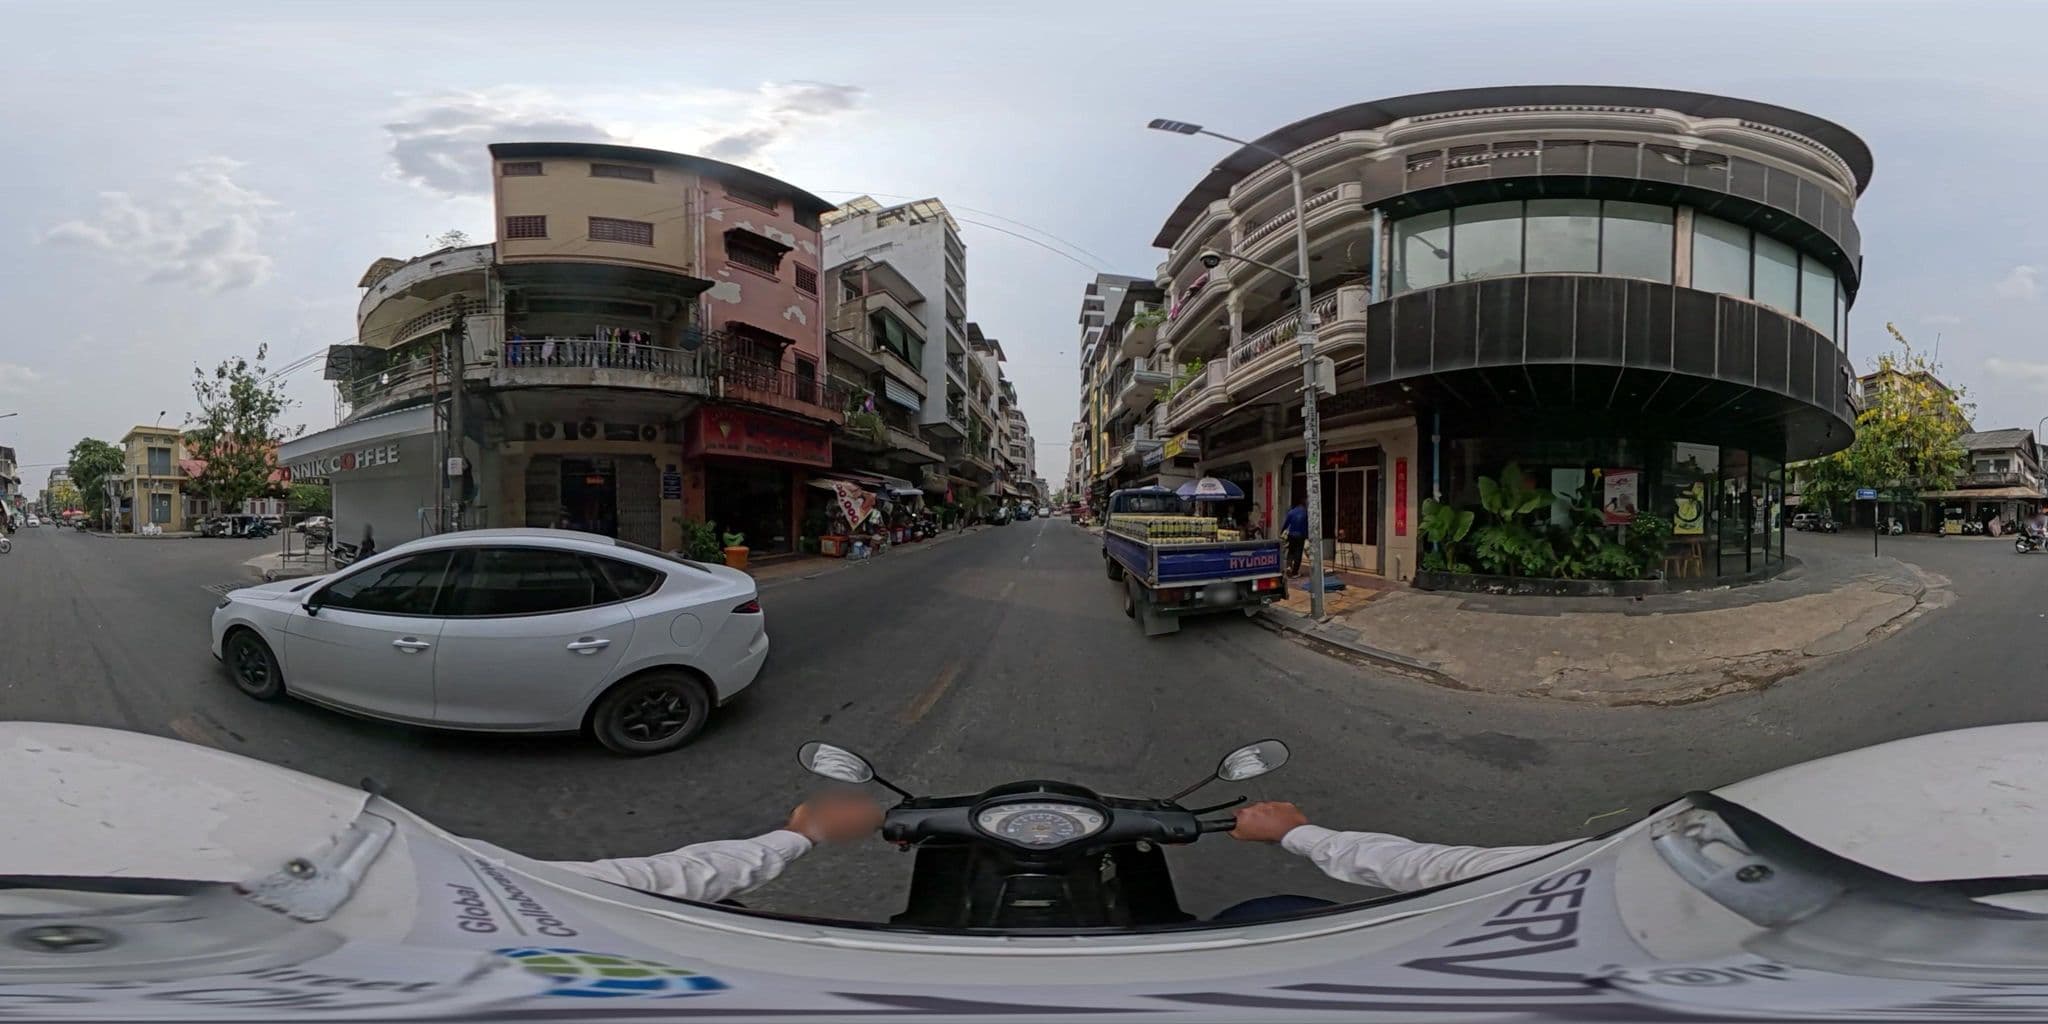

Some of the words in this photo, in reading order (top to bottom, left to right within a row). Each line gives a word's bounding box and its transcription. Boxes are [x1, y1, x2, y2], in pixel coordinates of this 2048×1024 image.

[330, 443, 400, 474] COFFEE
[1230, 554, 1278, 569] HYUNDAI
[446, 883, 498, 933] Global
[474, 859, 578, 937] Collaborative
